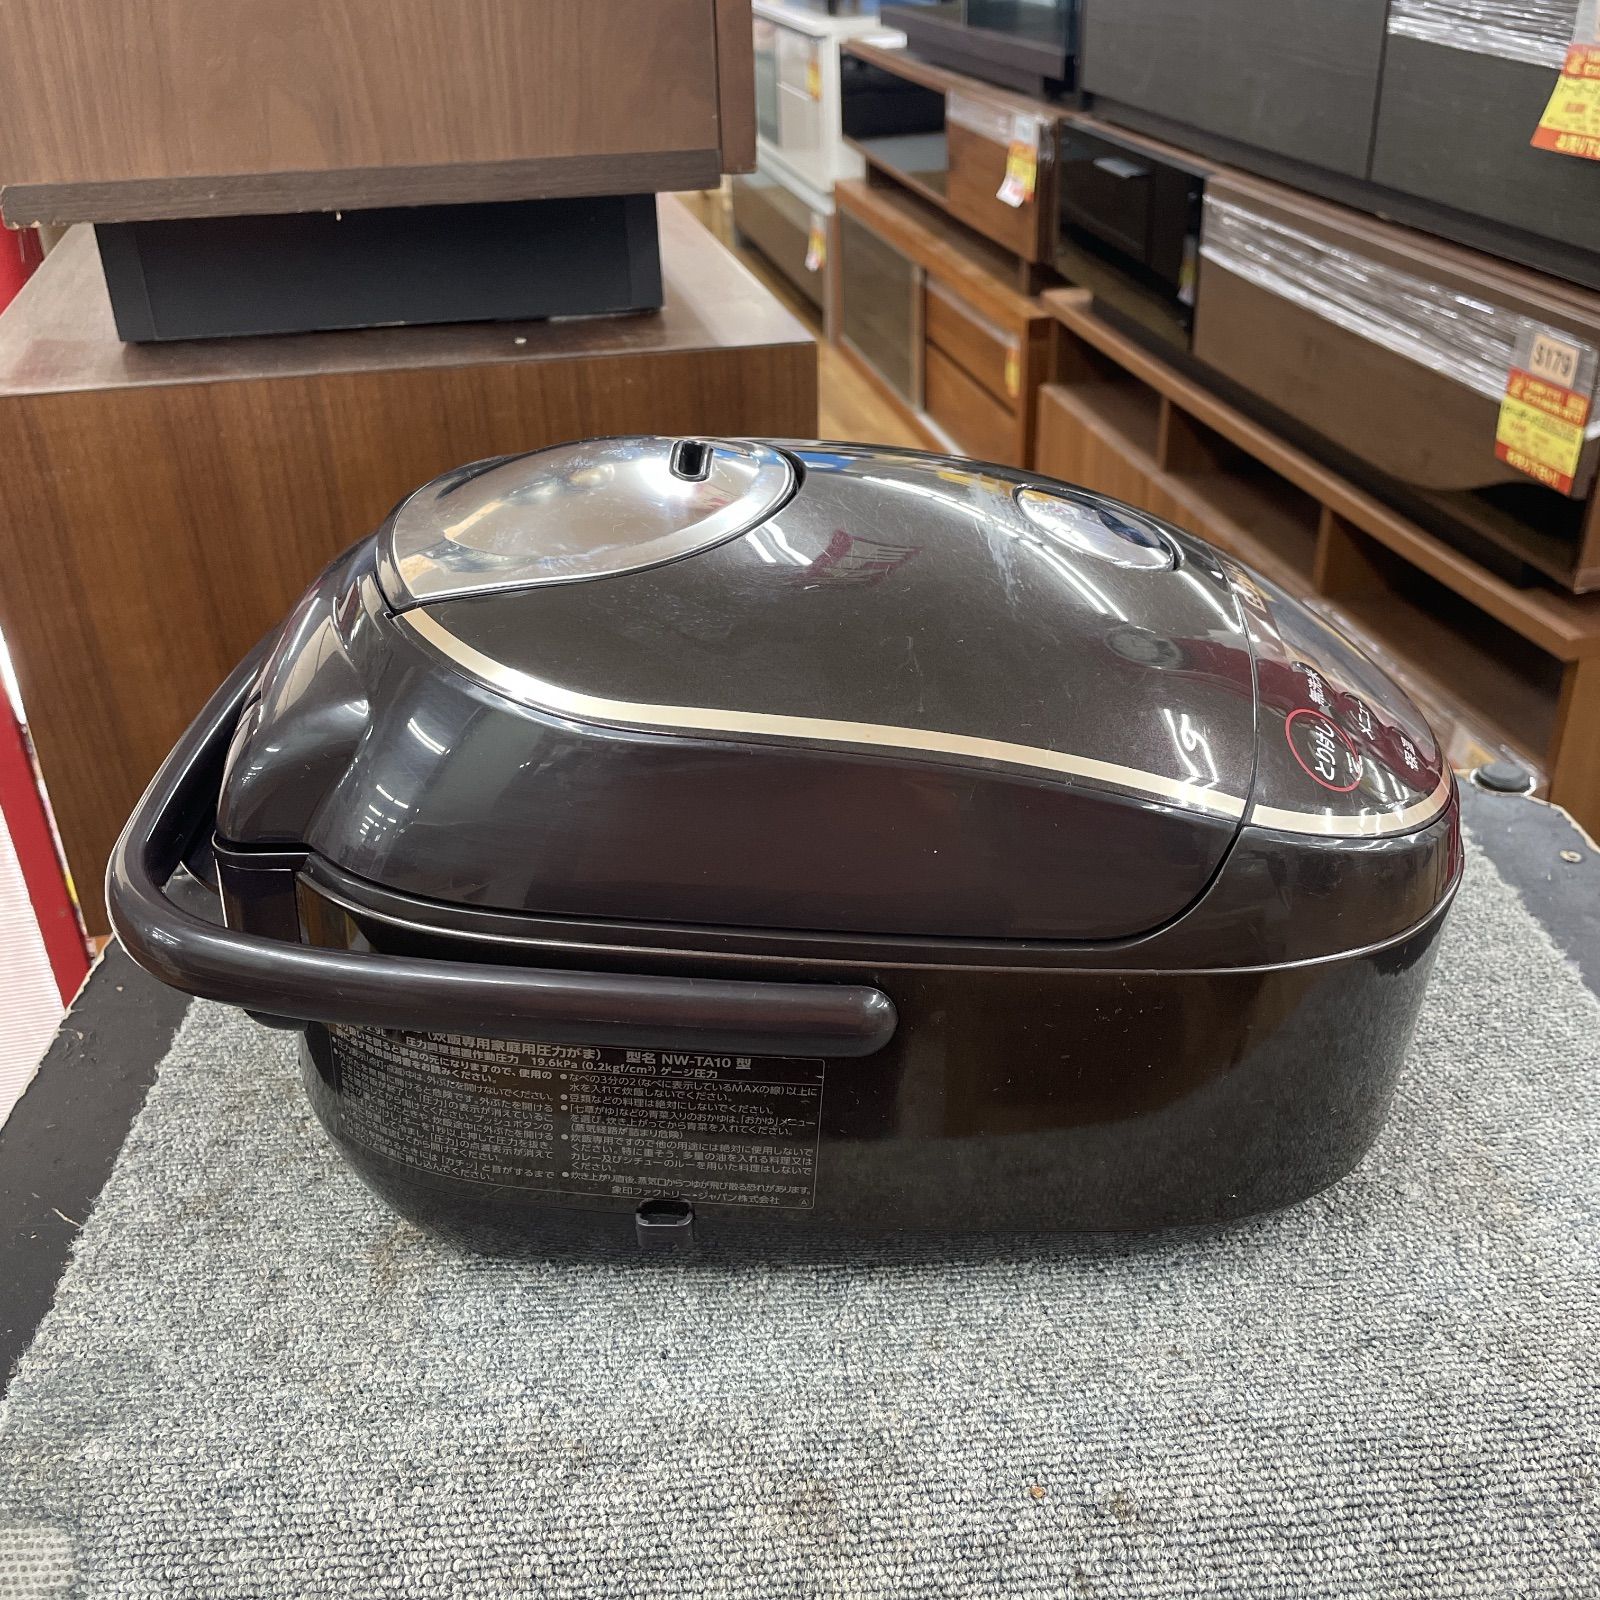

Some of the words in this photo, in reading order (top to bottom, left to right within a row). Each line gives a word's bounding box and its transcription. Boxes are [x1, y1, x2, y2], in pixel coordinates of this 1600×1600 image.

[1358, 700, 1375, 741] メニュー
[1314, 722, 1336, 781] とりけし
[531, 1057, 578, 1069] 19.6kPa
[660, 1066, 718, 1079] ゲージ圧力
[626, 1051, 657, 1065] 型名
[661, 1053, 732, 1068] NW-TA10
[736, 1057, 752, 1070] 型
